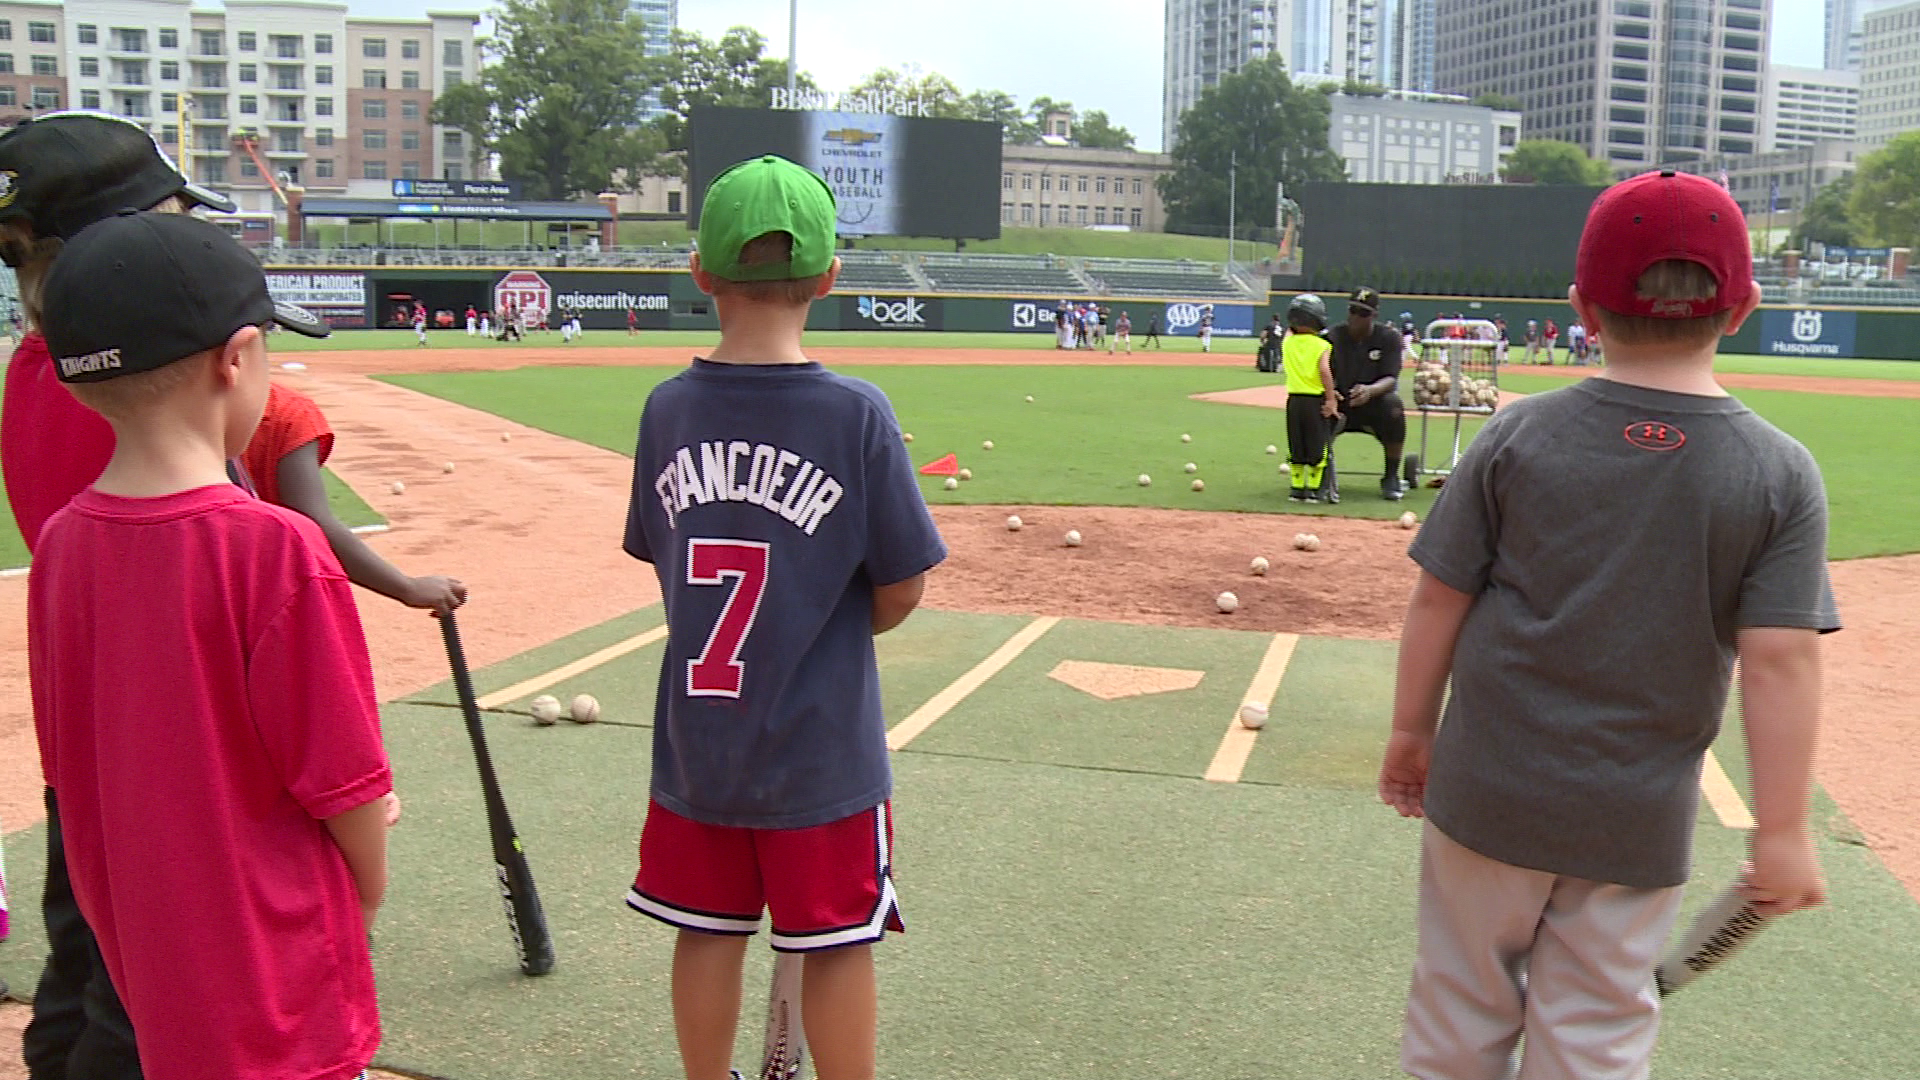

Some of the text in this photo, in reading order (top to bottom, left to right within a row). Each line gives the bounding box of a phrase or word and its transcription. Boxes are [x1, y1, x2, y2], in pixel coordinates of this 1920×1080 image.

[839, 91, 931, 117] BallPark
[821, 148, 883, 158] CHEVROLET
[822, 166, 883, 185] YOUTH
[832, 185, 883, 198] ASEBALL
[313, 275, 365, 290] PRODUCT
[557, 292, 669, 310] cpisecurity.com
[871, 295, 926, 322] belk
[1169, 304, 1200, 325] AAA
[1771, 340, 1839, 354] Husqvarna
[58, 348, 123, 378] KNIGHTS
[655, 439, 844, 537] FRANCOEUR
[686, 537, 771, 698] 7
